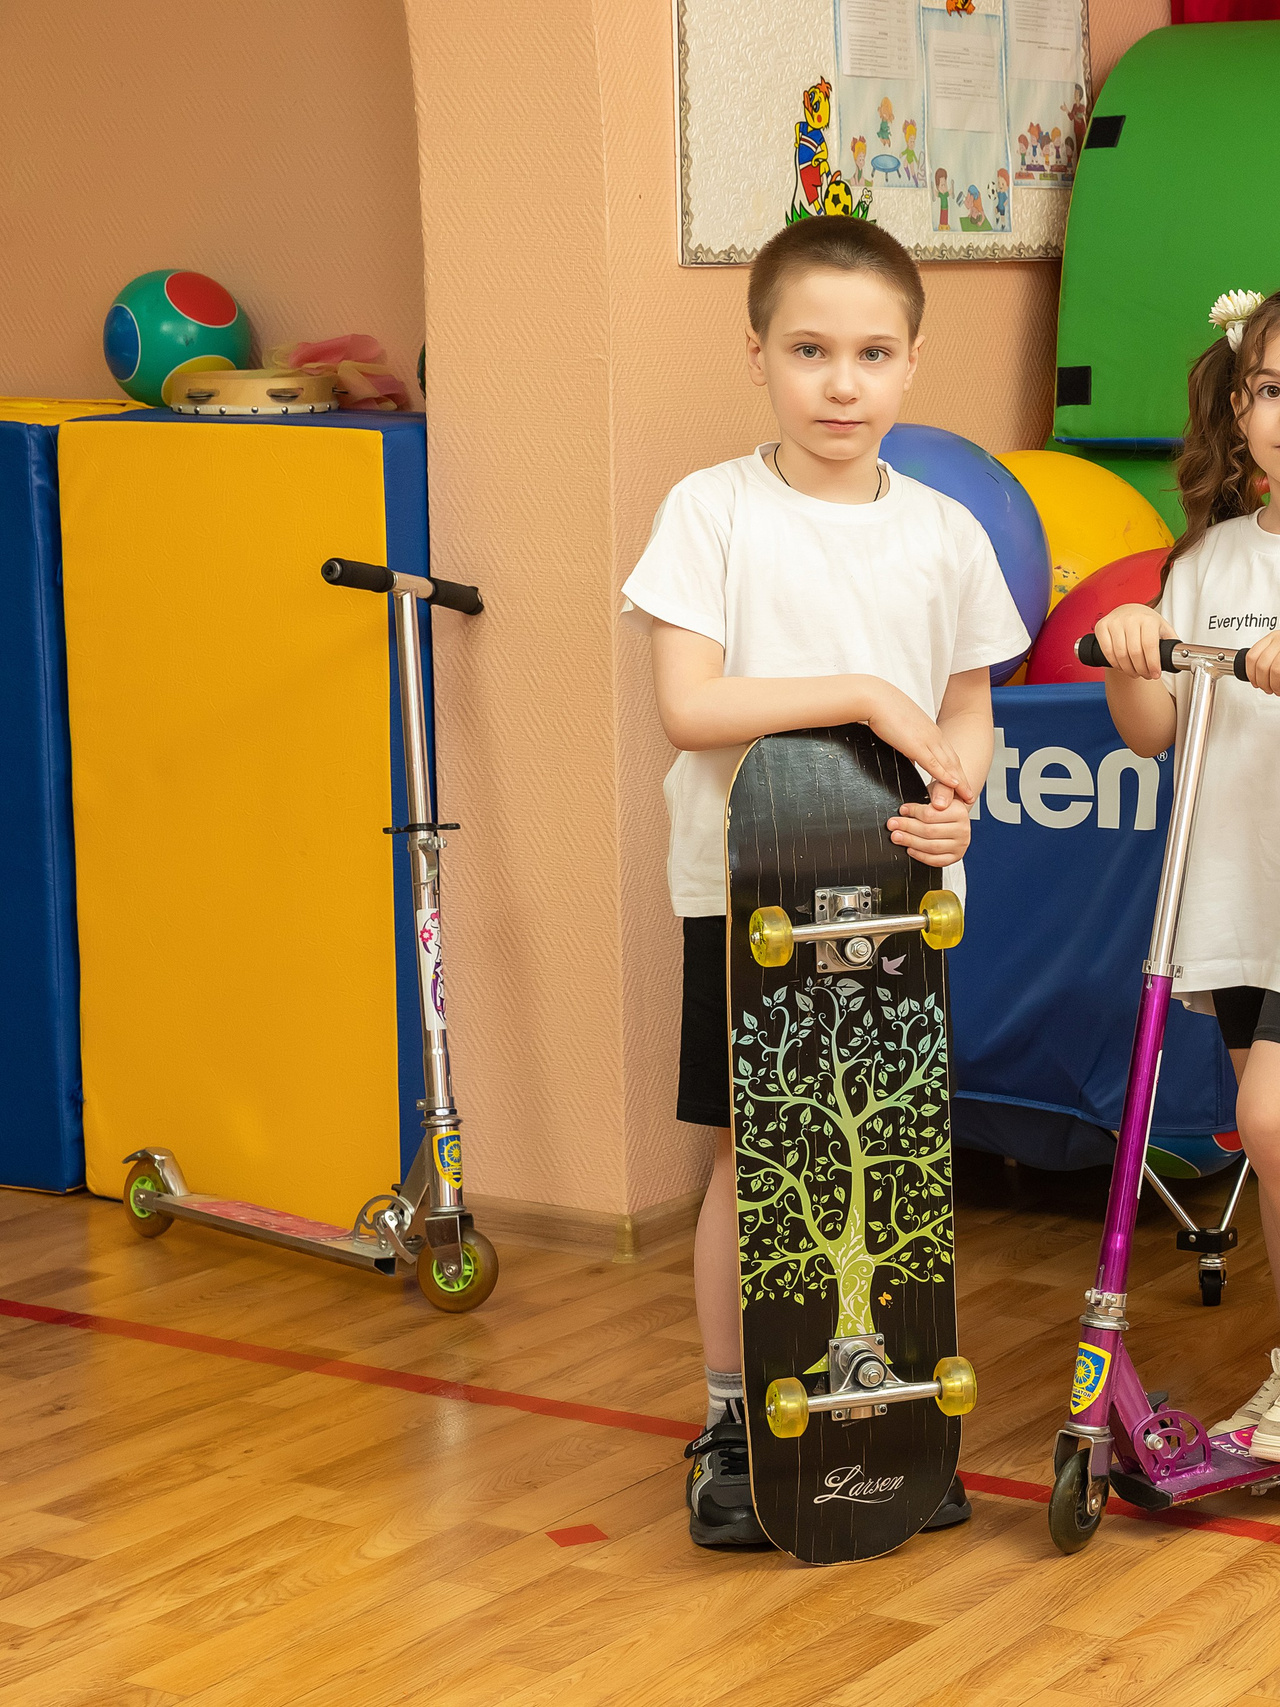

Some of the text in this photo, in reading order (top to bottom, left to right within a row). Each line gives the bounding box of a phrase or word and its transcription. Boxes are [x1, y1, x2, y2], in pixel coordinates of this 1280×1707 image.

[1208, 613, 1278, 631] Everything
[969, 727, 1160, 831] ten
[813, 1464, 905, 1504] Larsen
